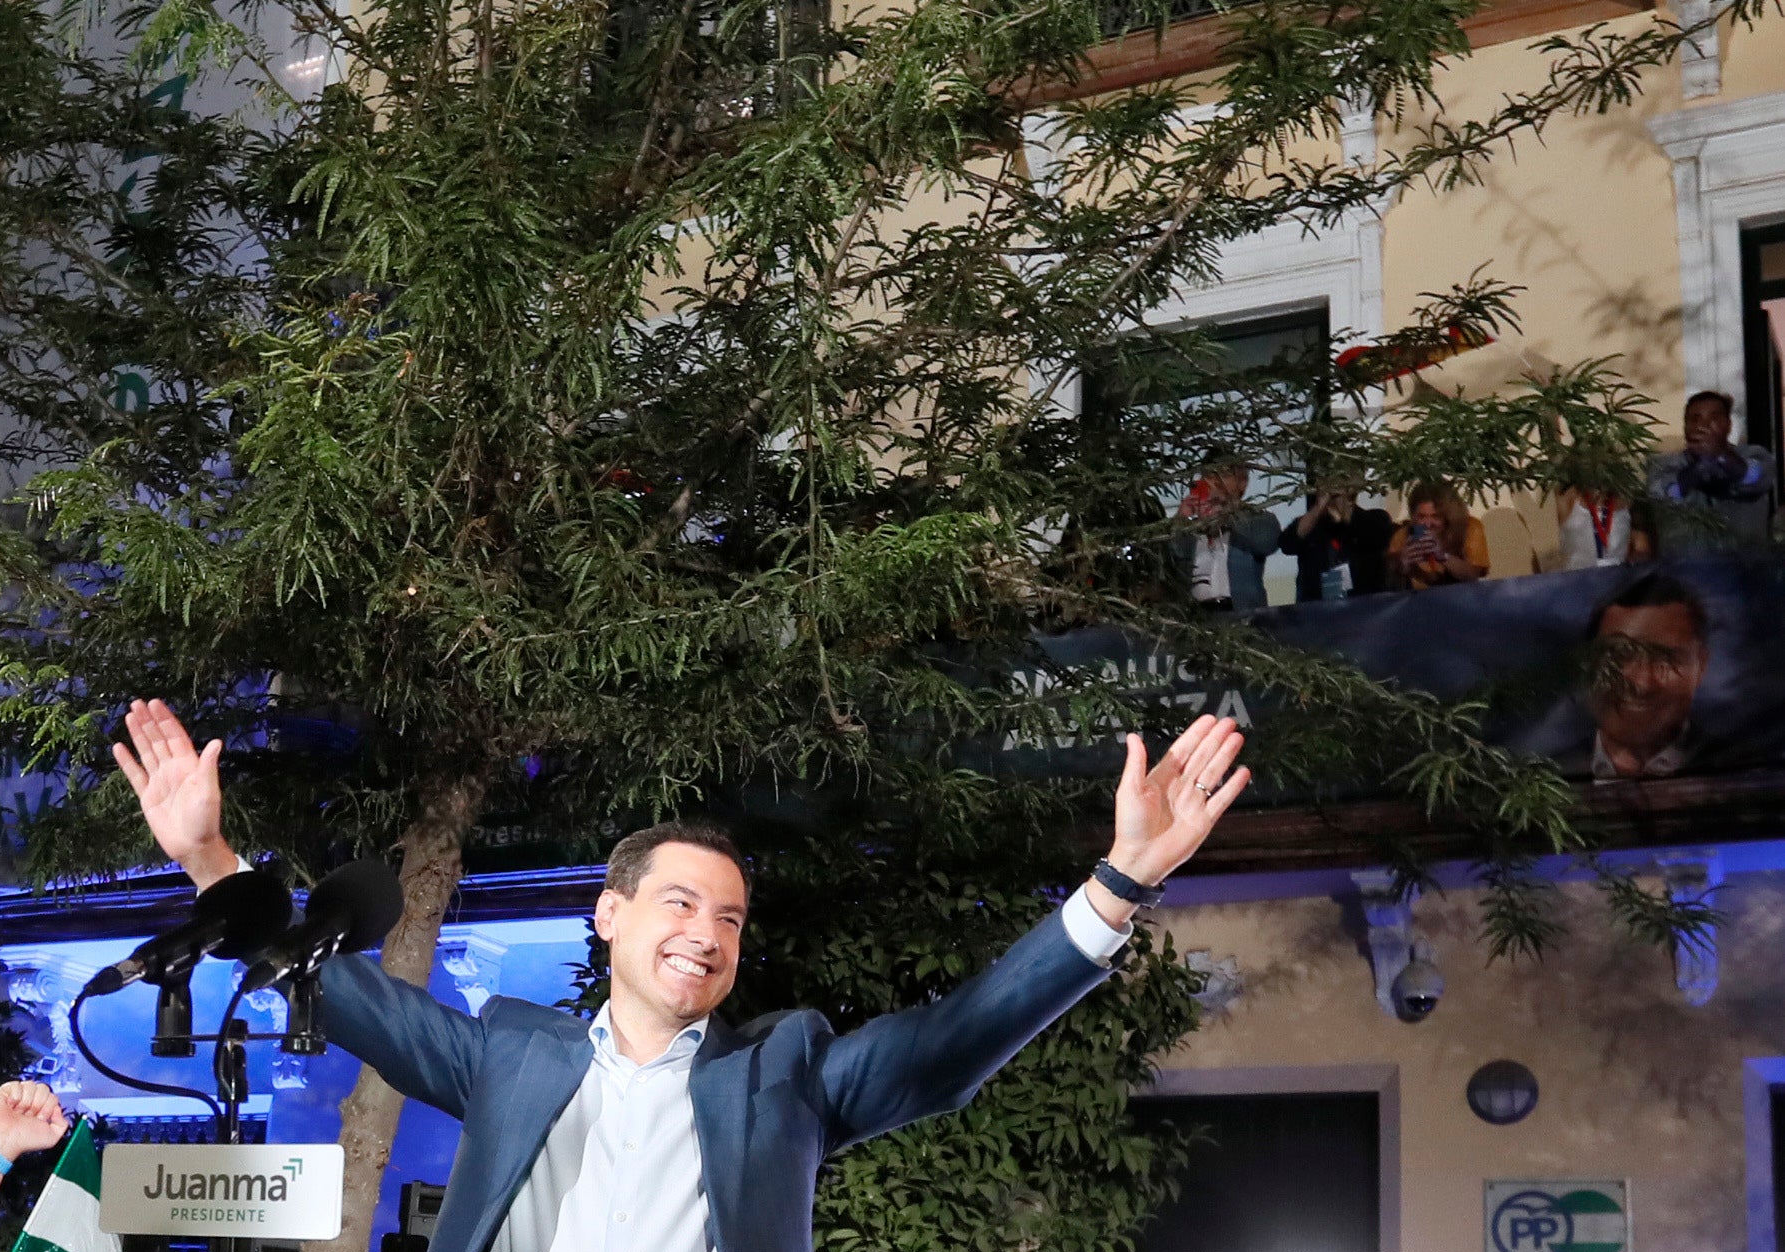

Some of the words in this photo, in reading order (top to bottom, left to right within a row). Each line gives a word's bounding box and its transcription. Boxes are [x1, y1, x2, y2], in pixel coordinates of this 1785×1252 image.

[143, 1163, 287, 1202] Juanma
[171, 1207, 266, 1223] PRESIDENTE
[1510, 1217, 1559, 1250] PP
